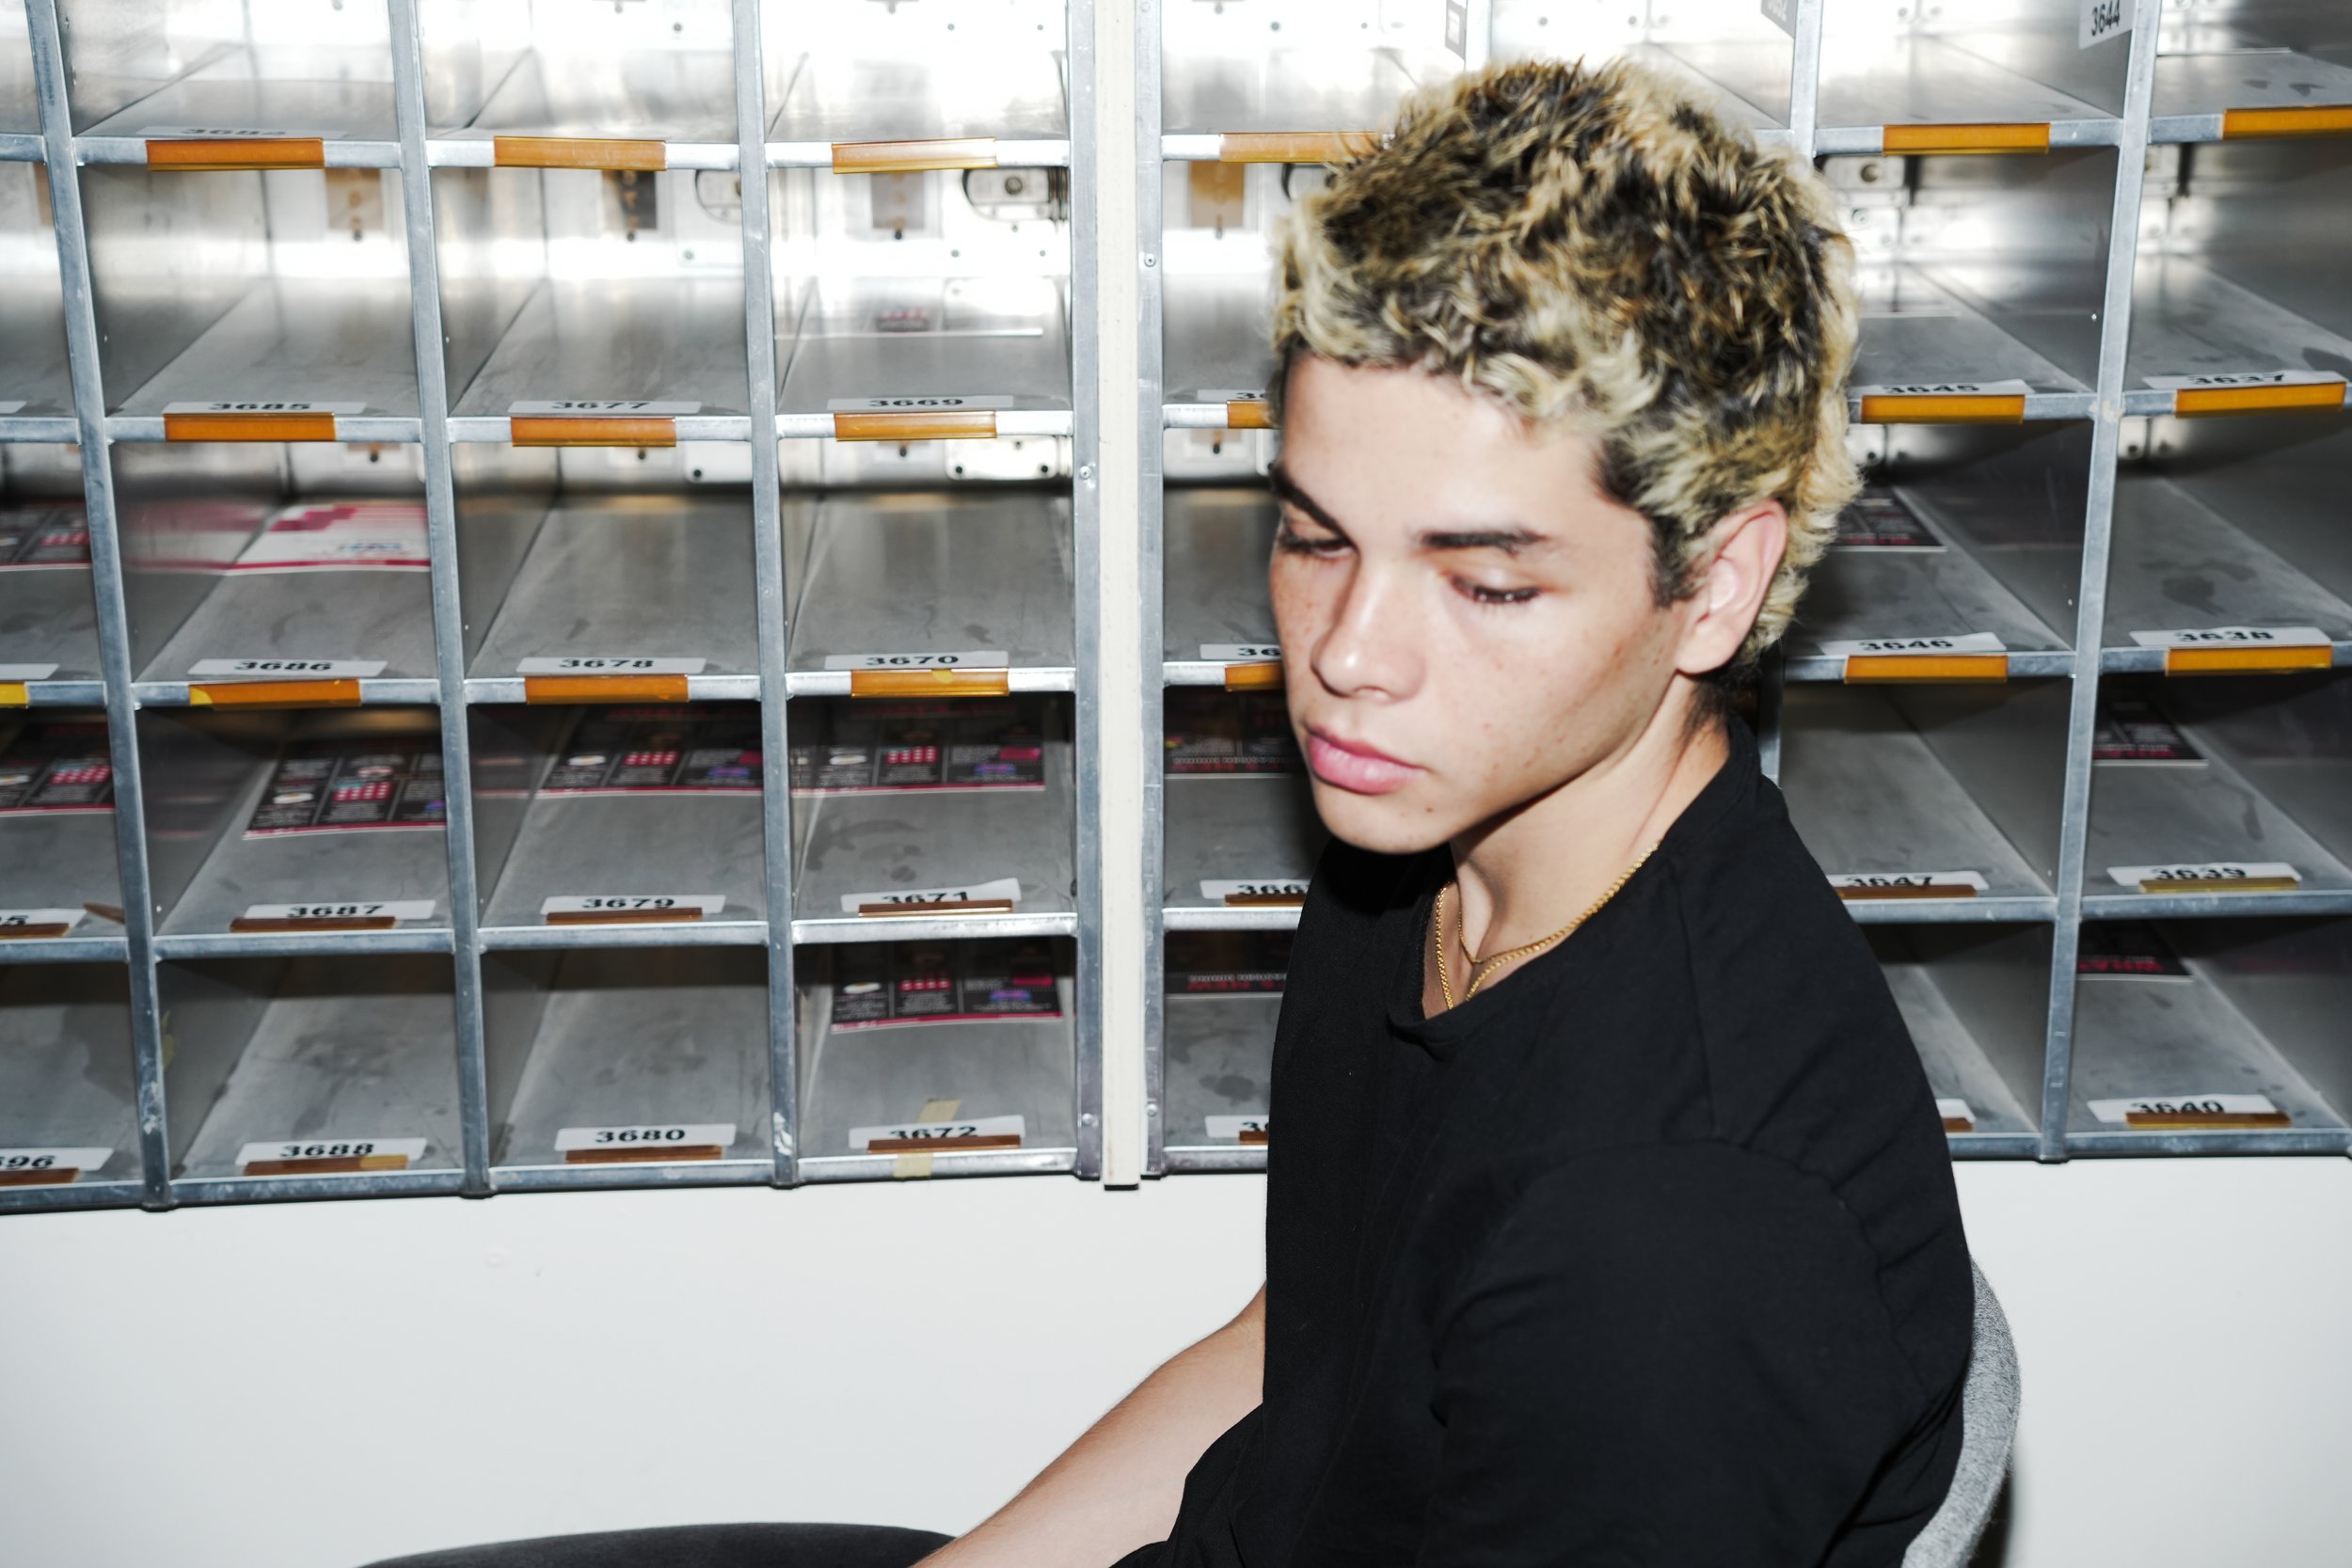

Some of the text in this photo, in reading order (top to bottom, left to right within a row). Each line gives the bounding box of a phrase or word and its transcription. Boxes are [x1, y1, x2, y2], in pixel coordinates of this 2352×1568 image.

[2091, 0, 2121, 37] 3644
[1883, 385, 1979, 393] 3645
[208, 403, 311, 411] 3685
[2175, 631, 2274, 641] 3638
[1859, 639, 1953, 650] 3646
[235, 661, 332, 671] 3686
[559, 659, 654, 669] 3678
[866, 656, 959, 666] 3670
[1237, 884, 1308, 895] 366
[582, 897, 675, 909] 3679
[286, 904, 383, 917] 3687
[596, 1129, 686, 1143] 3680
[280, 1143, 374, 1158] 3688
